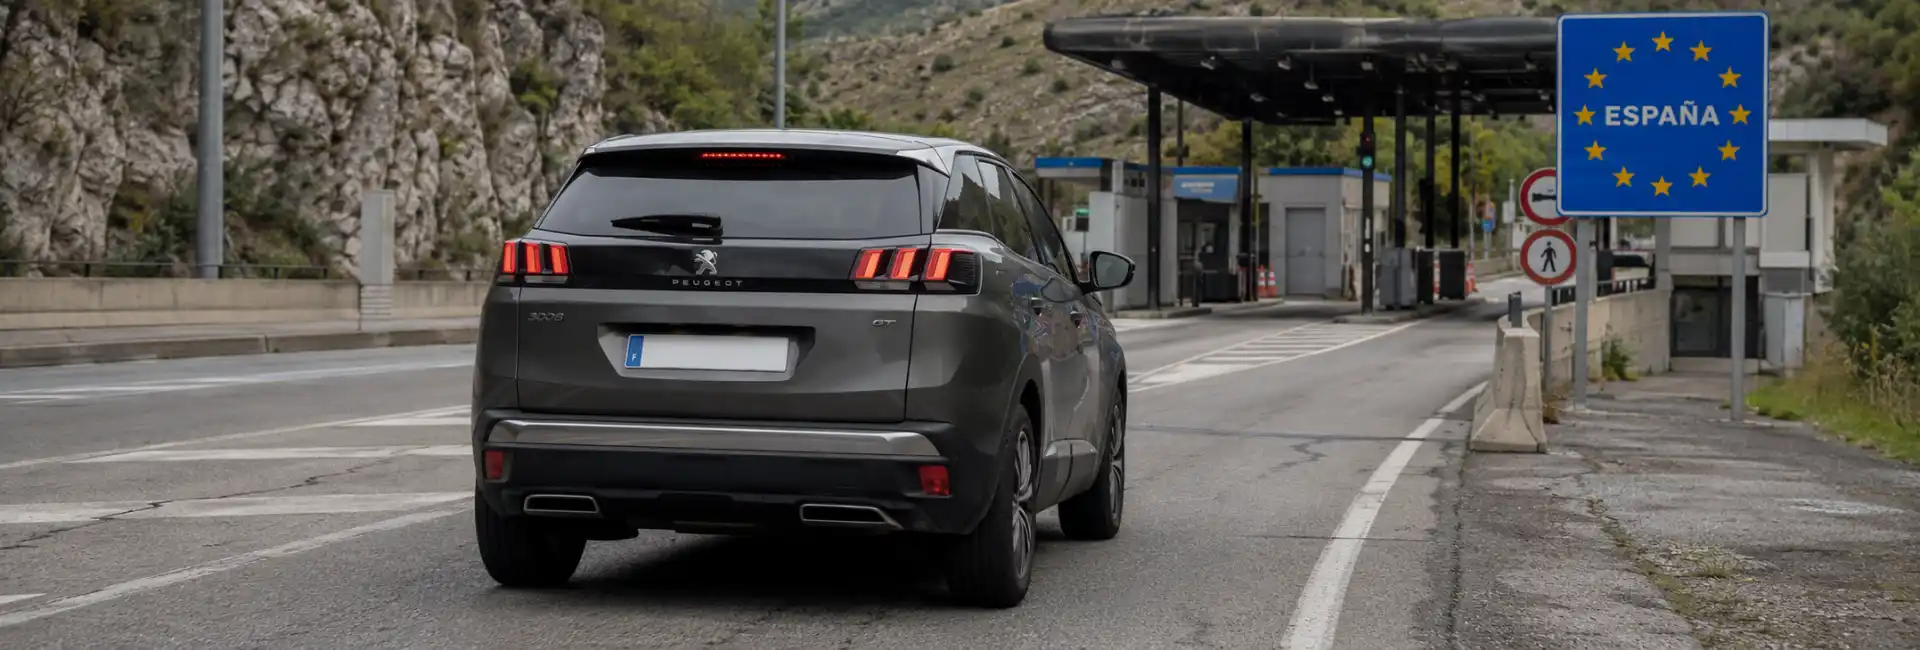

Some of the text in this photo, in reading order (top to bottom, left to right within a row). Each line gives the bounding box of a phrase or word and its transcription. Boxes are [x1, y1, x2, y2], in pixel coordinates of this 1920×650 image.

[1605, 100, 1720, 126] ESPAÑA
[528, 312, 564, 321] 3008
[872, 319, 897, 327] GT
